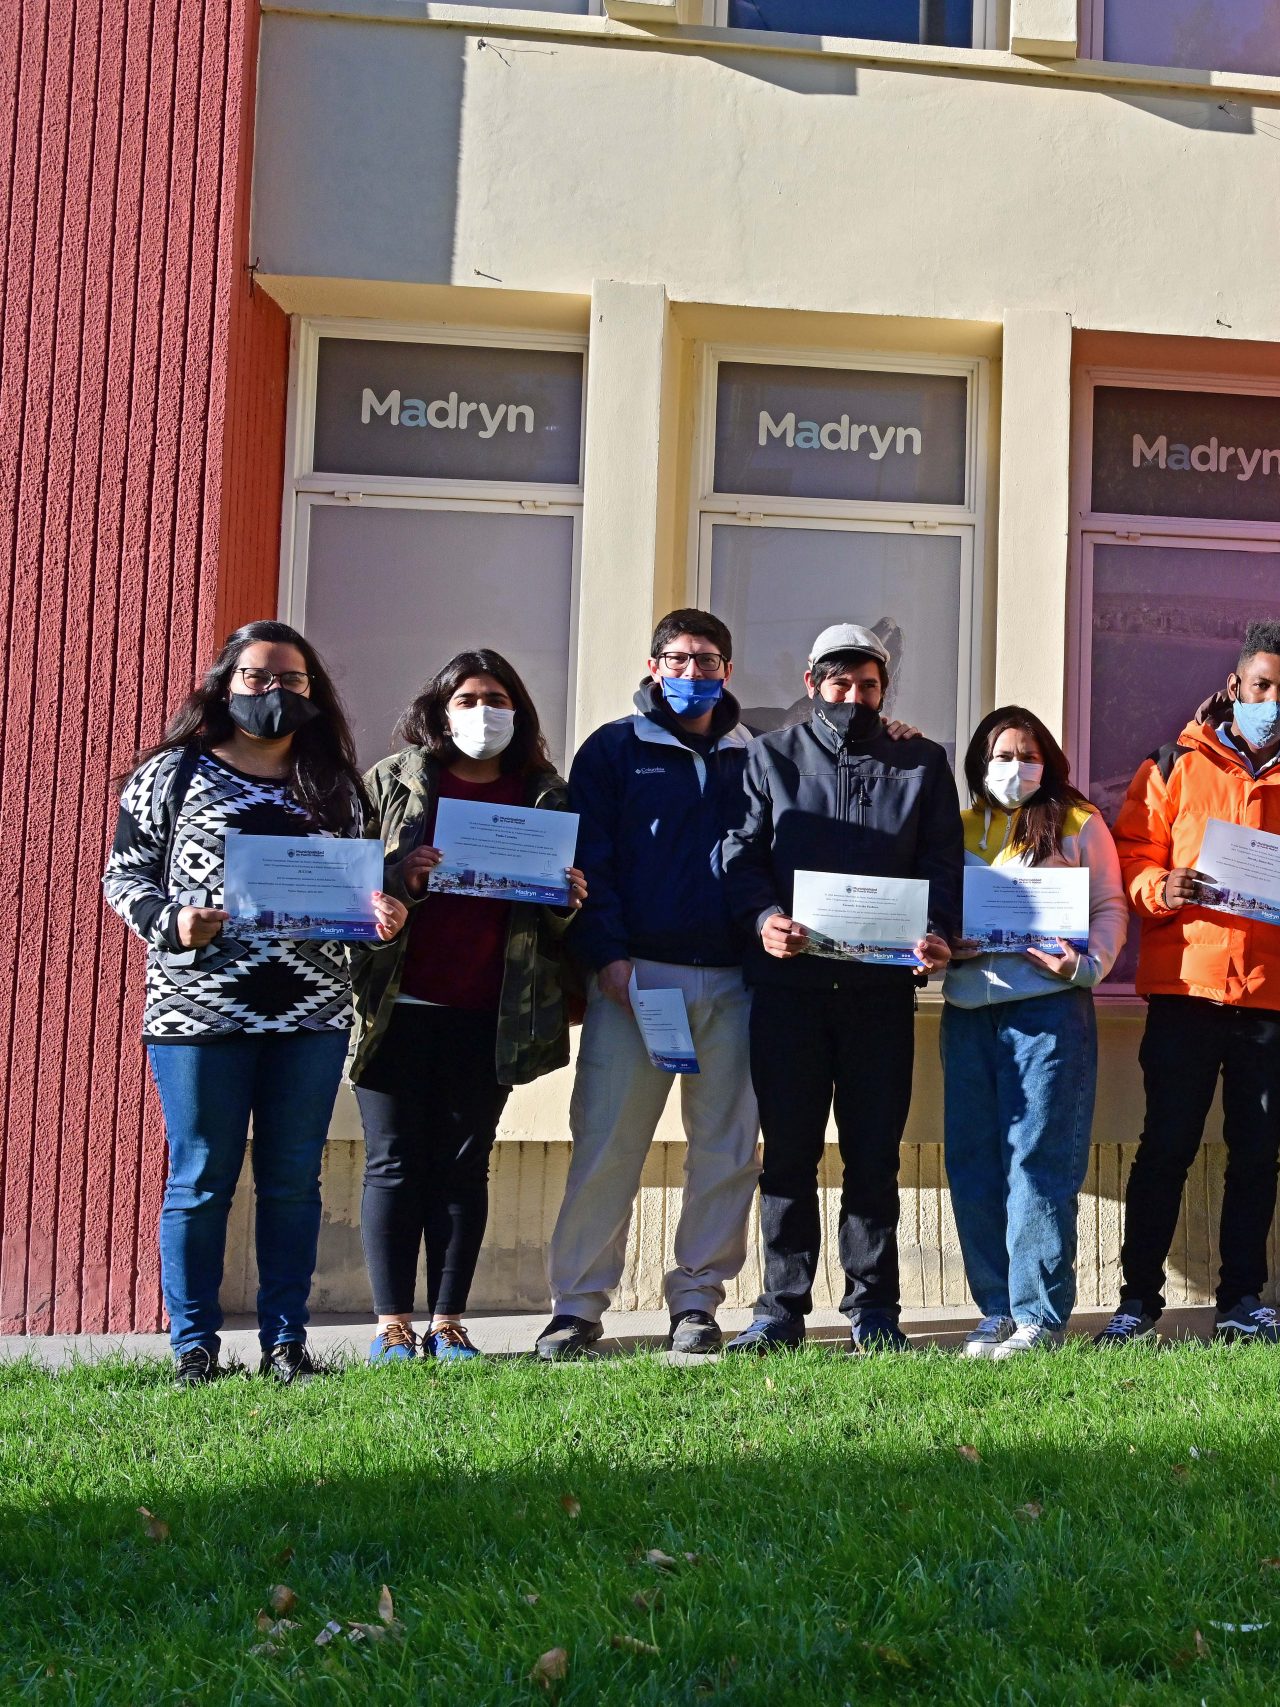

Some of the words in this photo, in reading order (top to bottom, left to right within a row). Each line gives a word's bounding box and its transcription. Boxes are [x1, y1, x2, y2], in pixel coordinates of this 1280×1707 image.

[361, 387, 535, 439] Madryn
[758, 410, 922, 461] Madryn
[515, 889, 537, 897] Madryn
